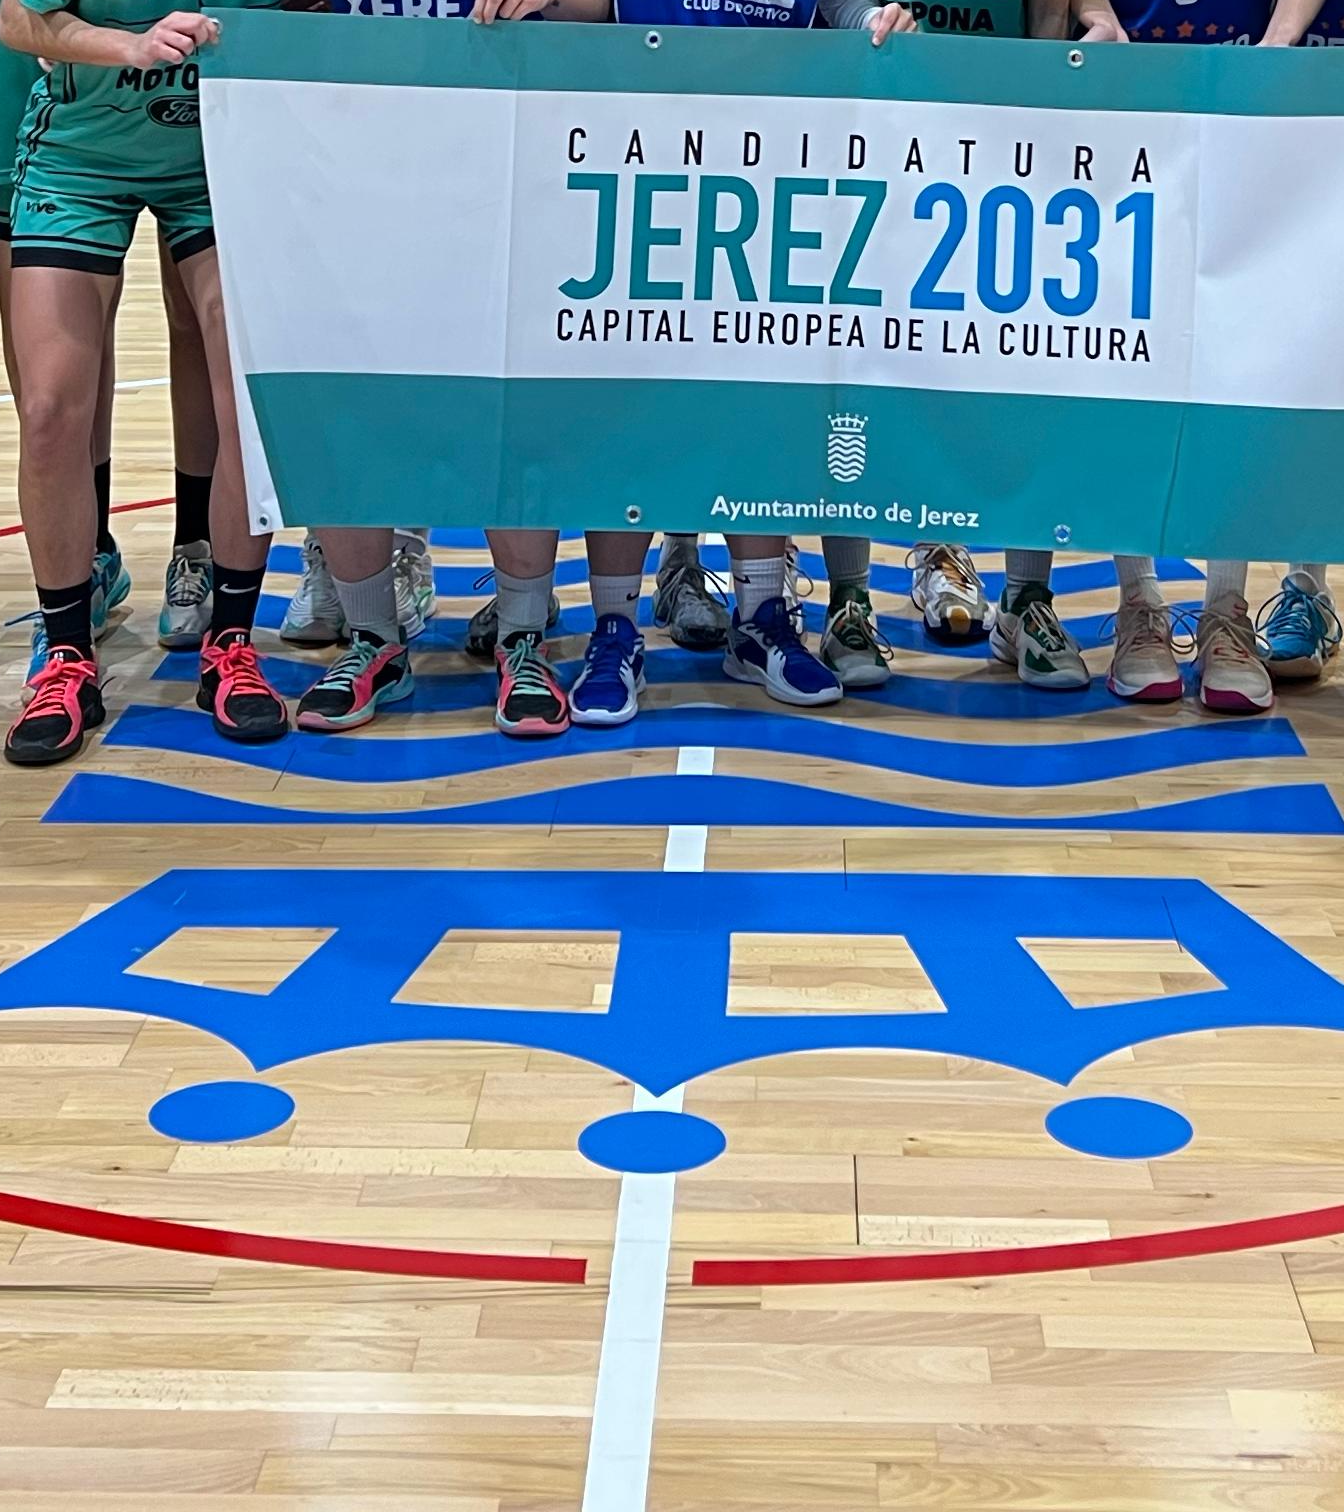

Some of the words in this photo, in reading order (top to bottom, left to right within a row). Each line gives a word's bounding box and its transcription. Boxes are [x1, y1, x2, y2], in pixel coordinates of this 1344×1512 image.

[911, 1, 994, 31] PONA
[116, 62, 198, 92] MOTO
[567, 126, 1153, 183] CANDIDATURA
[557, 172, 888, 307] JEREZ
[910, 181, 1154, 320] 2031
[557, 308, 693, 344] CAPITAL
[712, 311, 865, 349] EUROPEA
[885, 318, 924, 352] DE
[942, 321, 981, 355] LA
[998, 323, 1151, 363] CULTURA
[710, 495, 877, 521] Ayuntamiento
[884, 502, 912, 523] de
[917, 504, 979, 529] Jerez
